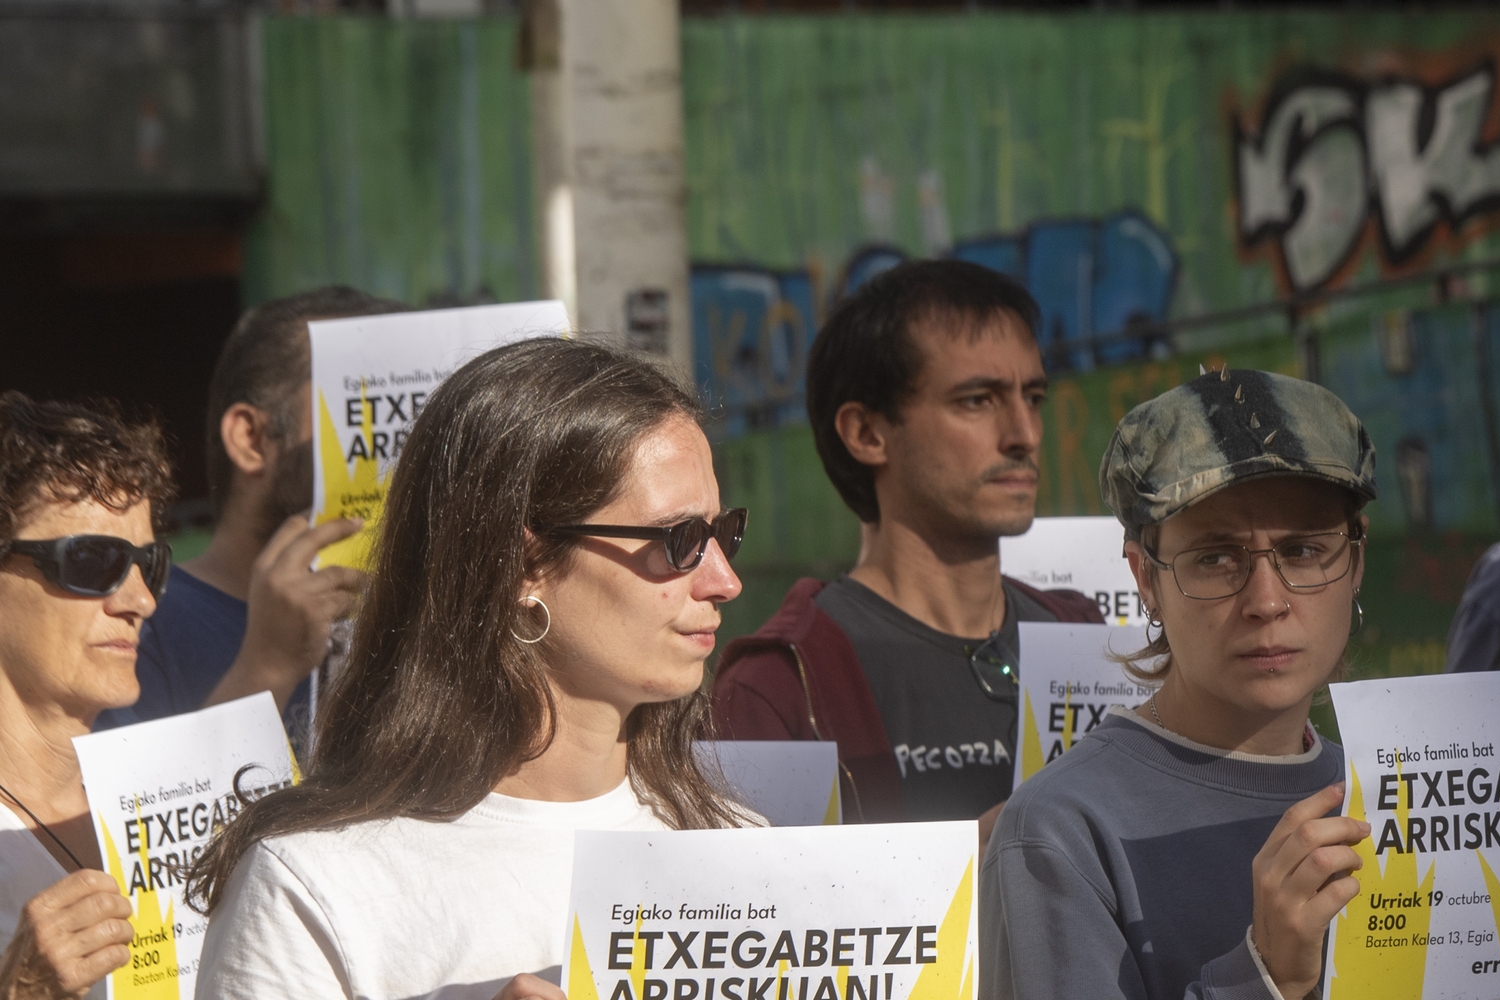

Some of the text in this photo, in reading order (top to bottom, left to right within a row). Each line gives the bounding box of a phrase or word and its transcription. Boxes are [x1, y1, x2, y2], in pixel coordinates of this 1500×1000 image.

[1049, 681, 1091, 698] Egiako
[1094, 681, 1133, 696] familia
[1377, 742, 1494, 768] Egiako familia bat
[1370, 891, 1491, 909] Urriak 19 octubre
[612, 903, 776, 925] Egiako familia bat
[1368, 914, 1406, 931] 8:00
[608, 925, 936, 970] ETXEGABETZE
[1366, 930, 1493, 948] Baztan Kalea 13, Egia
